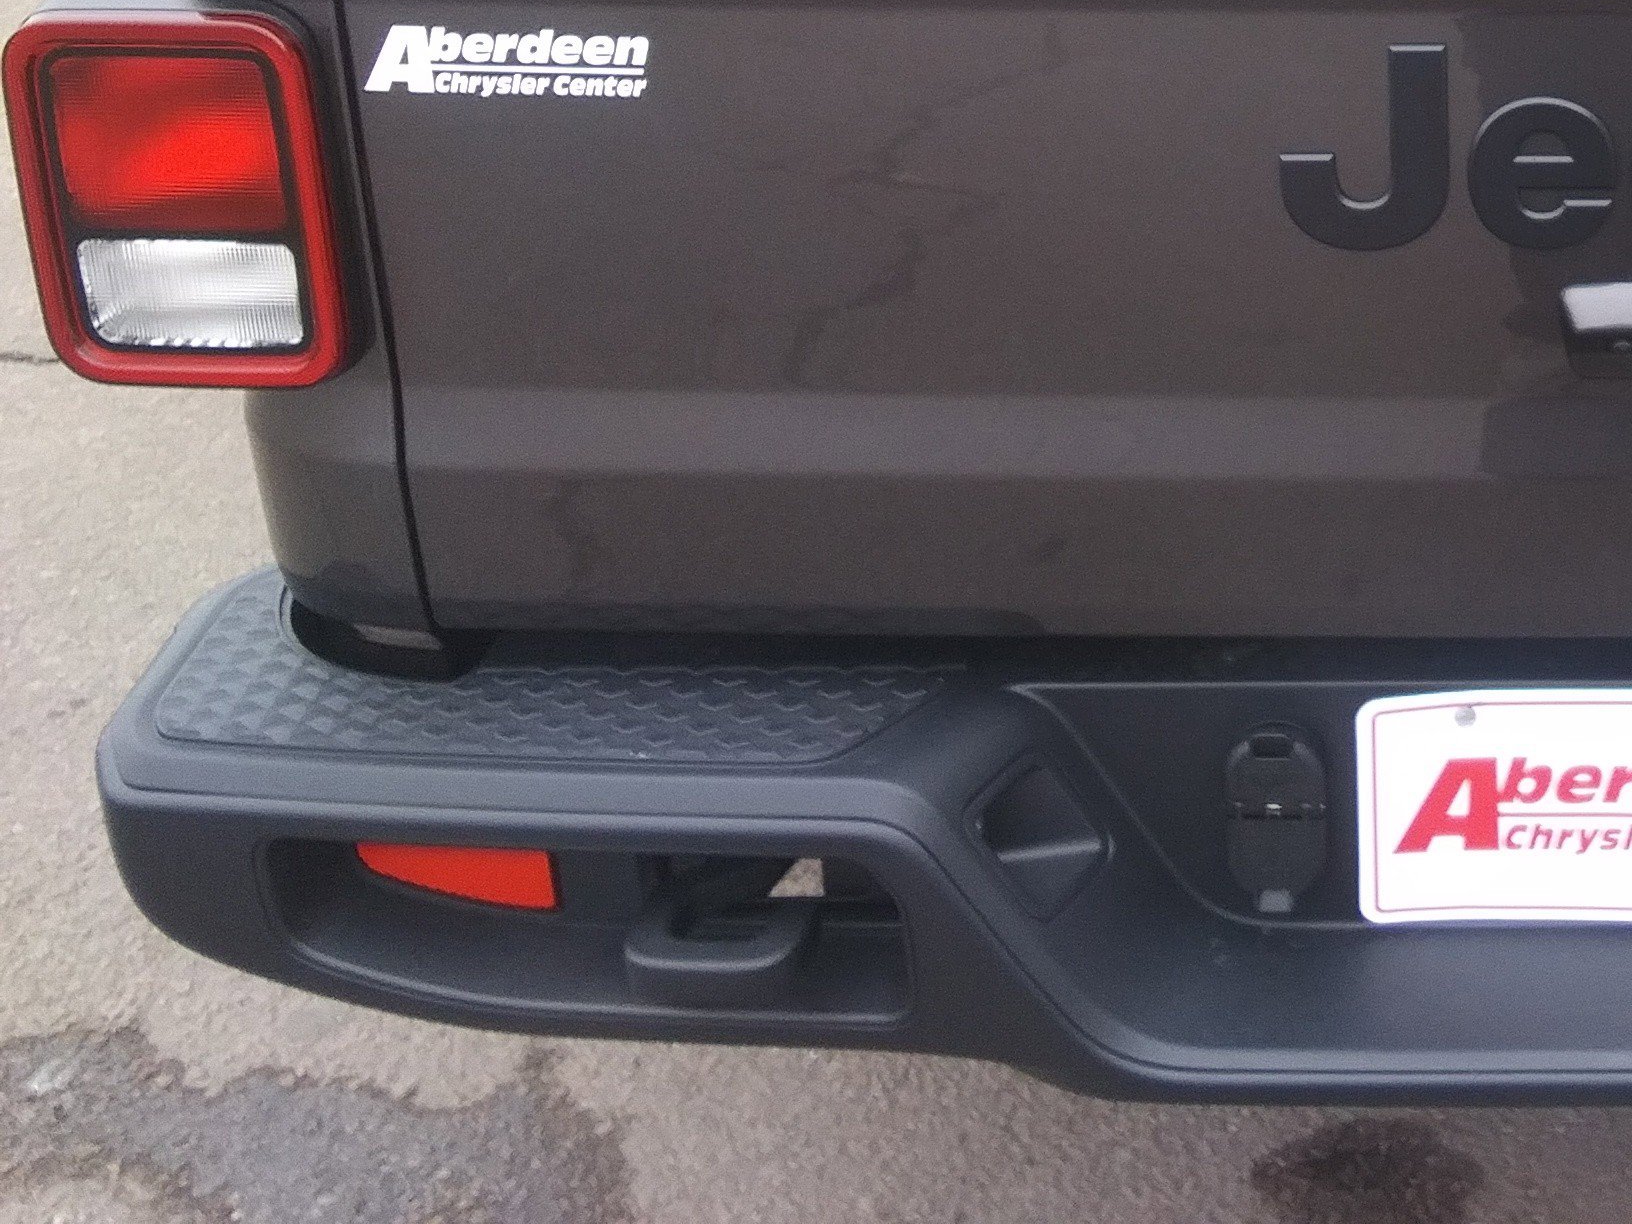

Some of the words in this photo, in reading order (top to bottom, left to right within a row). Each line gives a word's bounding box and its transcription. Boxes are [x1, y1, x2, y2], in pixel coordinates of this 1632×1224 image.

[363, 24, 651, 94] Aberdeen
[434, 72, 551, 98] Chrysler
[553, 75, 648, 98] Center
